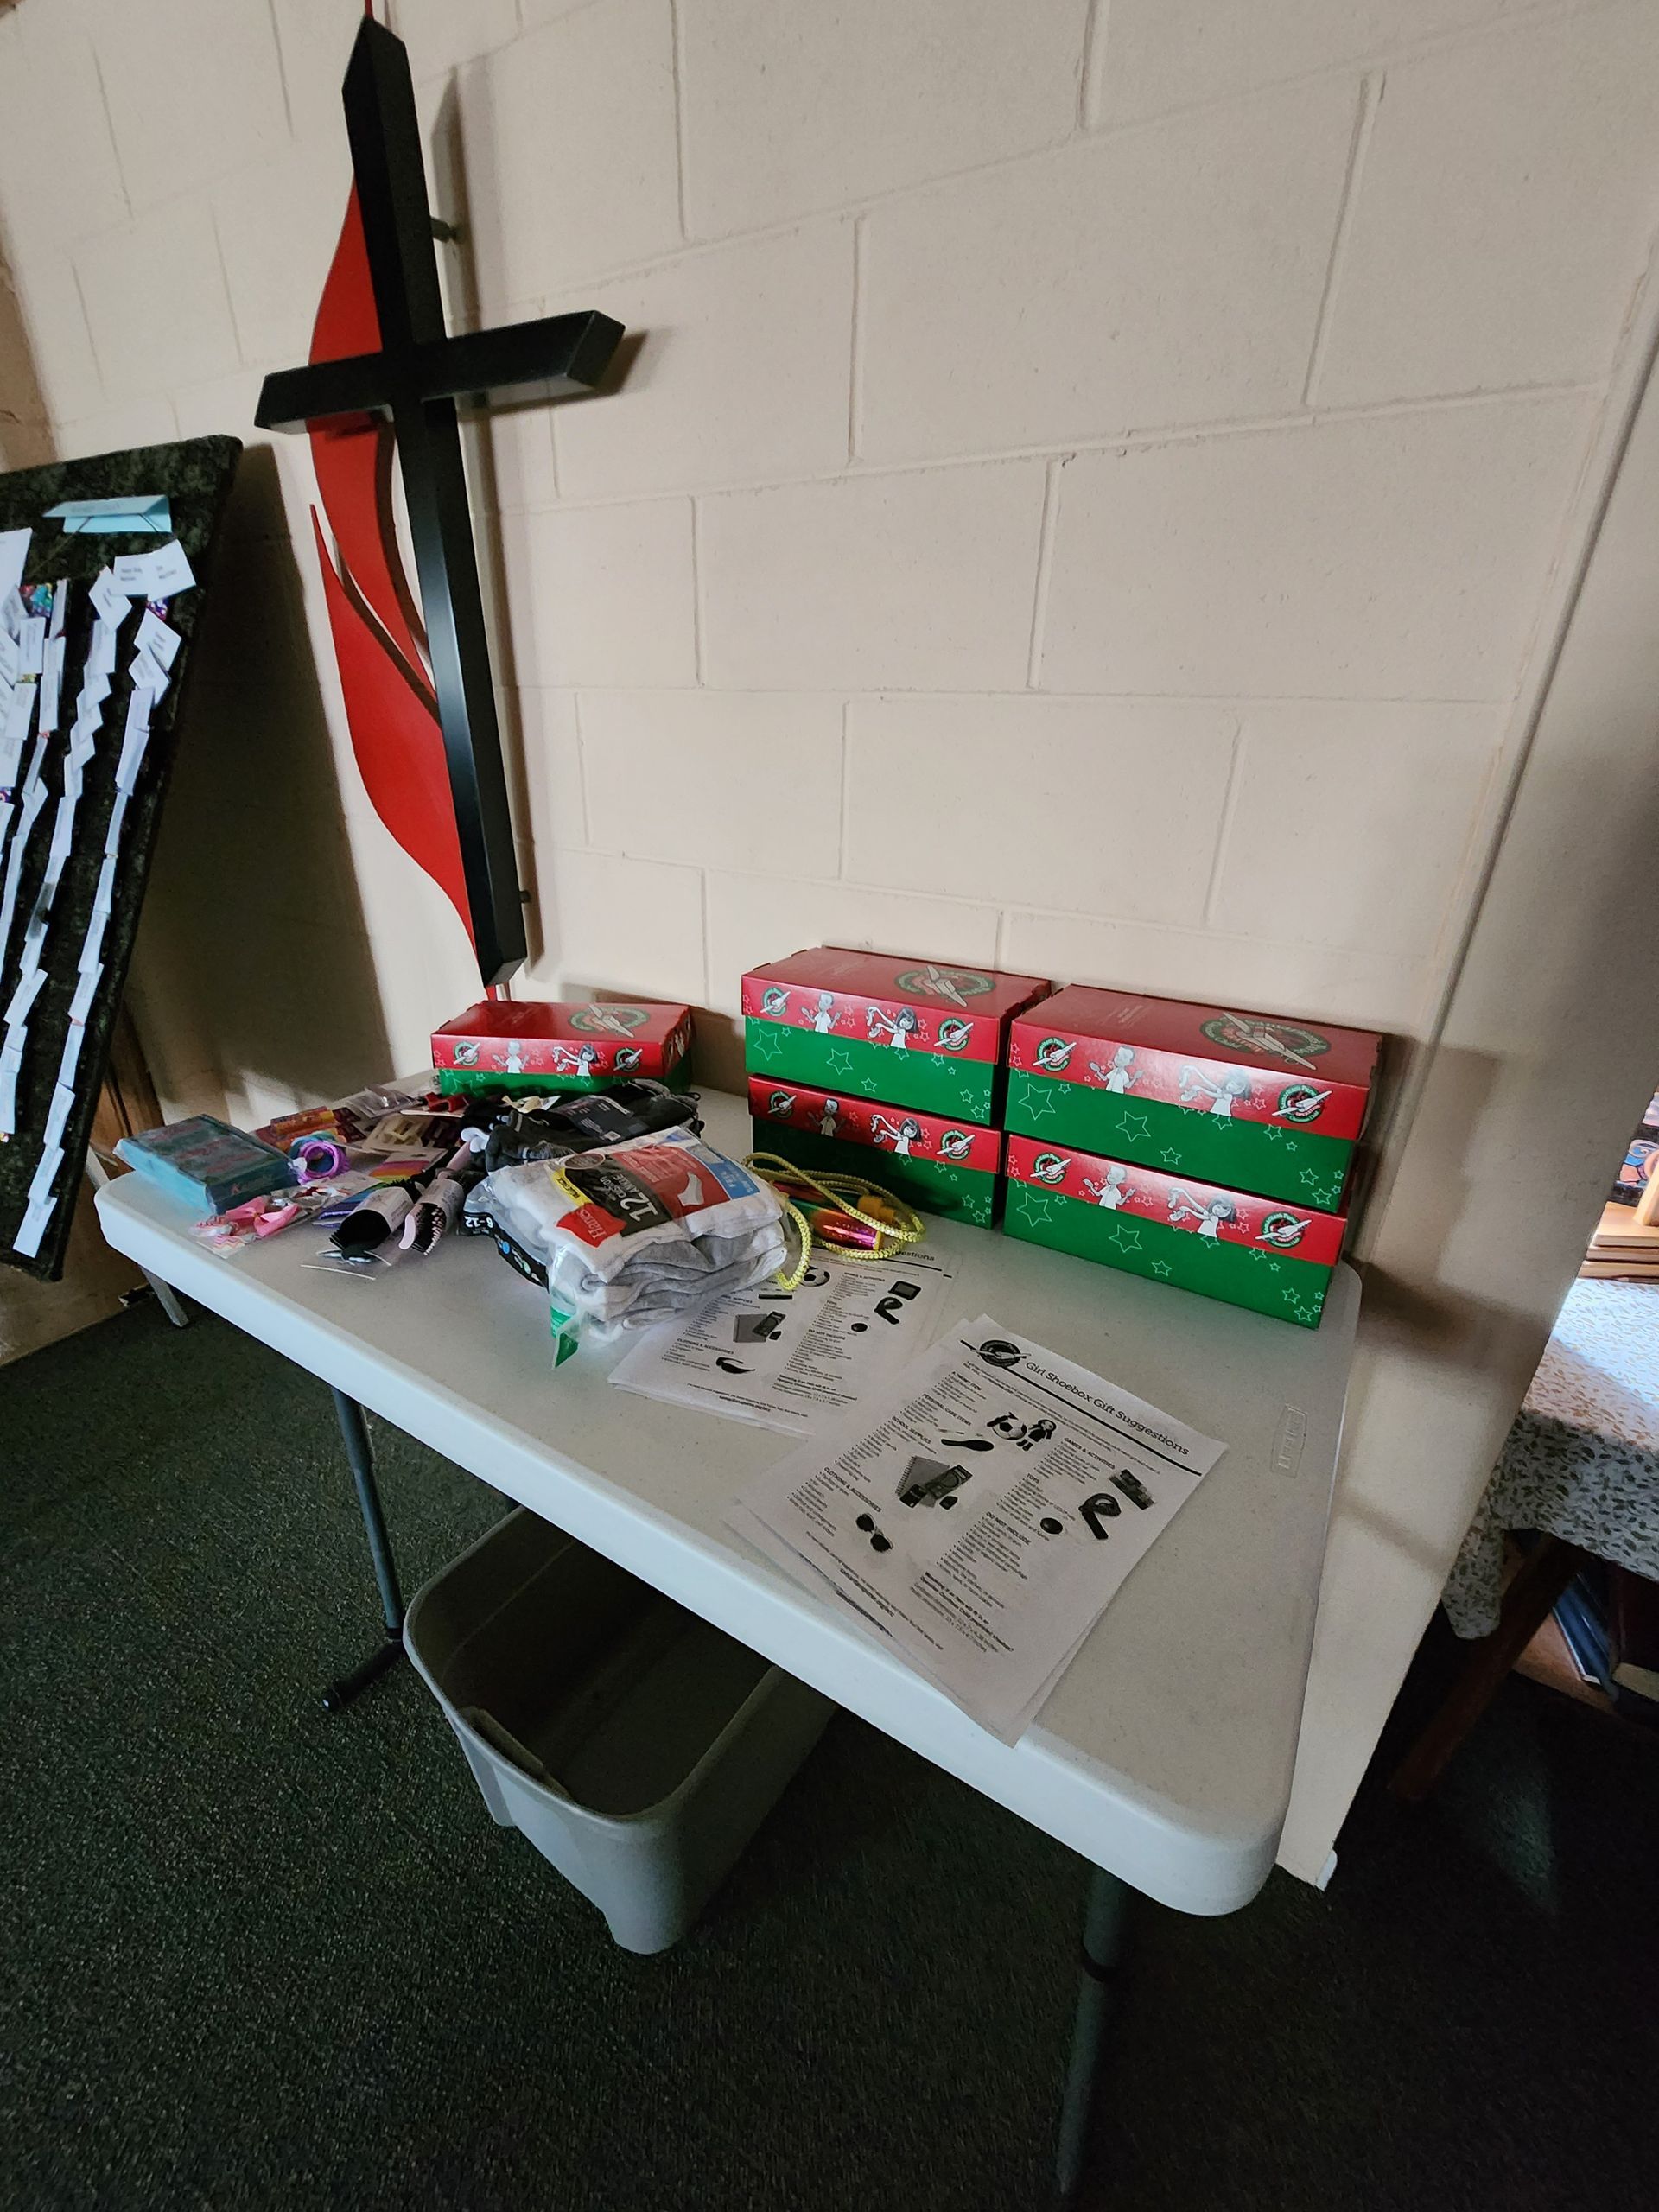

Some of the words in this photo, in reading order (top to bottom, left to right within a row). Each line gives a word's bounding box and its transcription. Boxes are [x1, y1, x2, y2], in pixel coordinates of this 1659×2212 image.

[464, 1215, 493, 1229] 6-12
[620, 1192, 659, 1222] 12
[577, 1209, 607, 1239] Hanes
[1026, 1361, 1046, 1376] Girl
[1046, 1371, 1094, 1402] Shoebox
[1093, 1397, 1116, 1416] Gift
[1116, 1409, 1190, 1457] Suggestions
